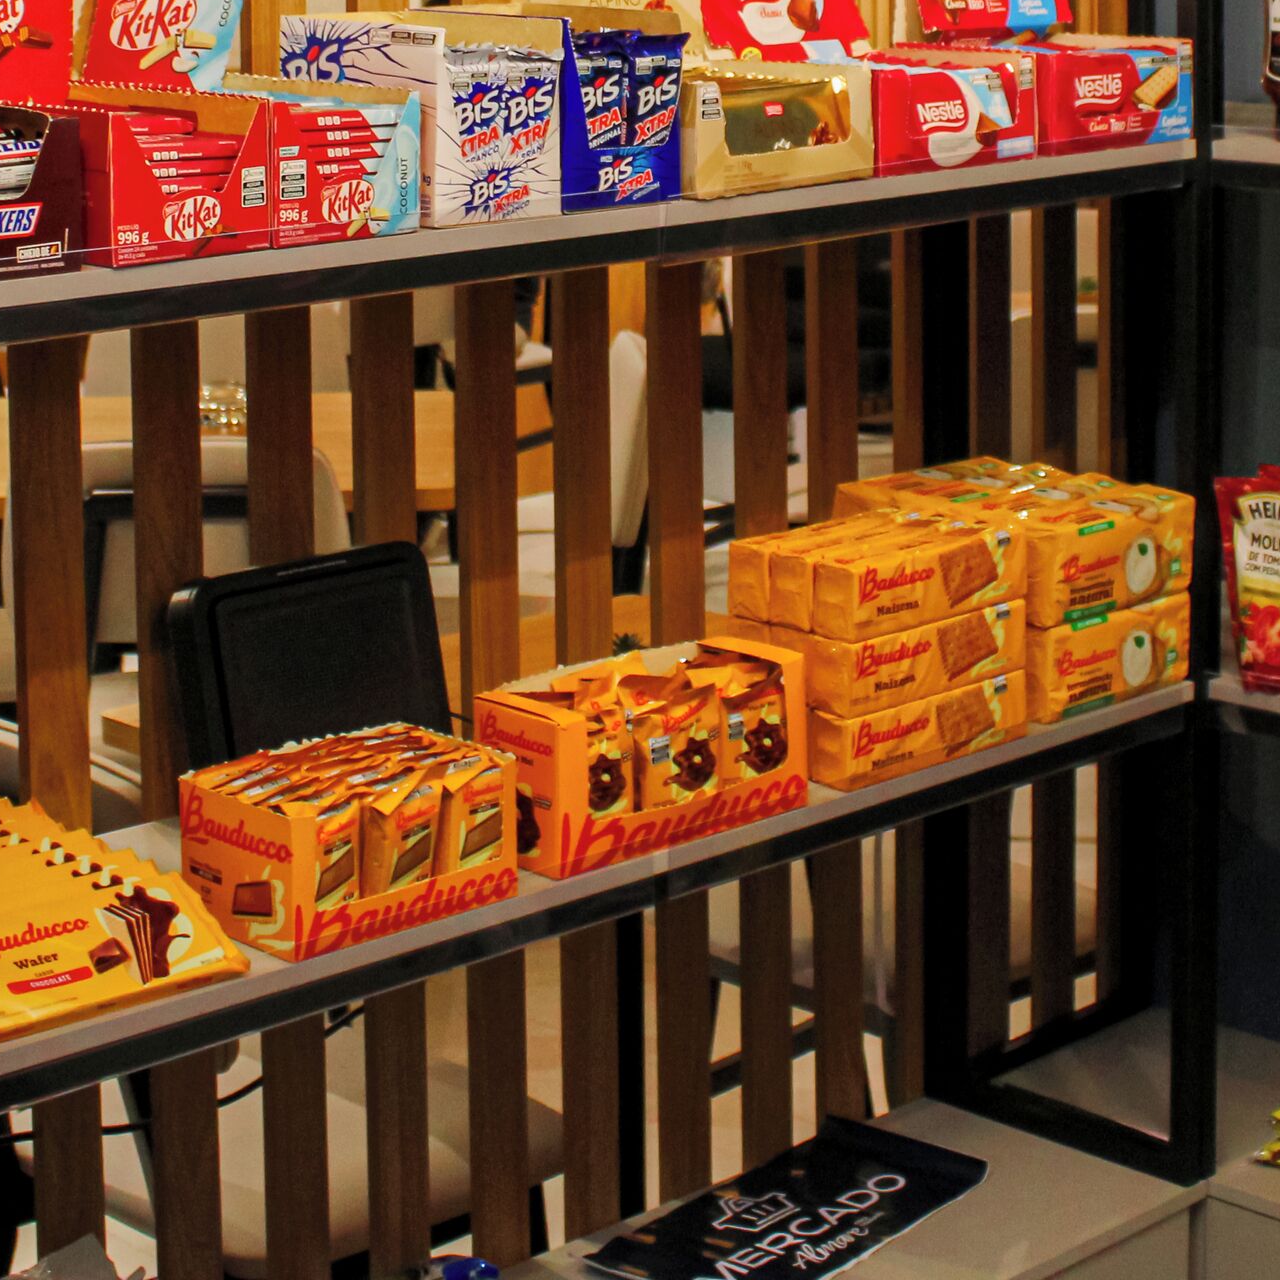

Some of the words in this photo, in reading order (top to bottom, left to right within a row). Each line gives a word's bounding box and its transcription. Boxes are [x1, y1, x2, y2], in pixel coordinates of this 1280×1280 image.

[400, 157, 408, 214] COCONUT
[118, 231, 139, 244] 996
[171, 197, 218, 240] KitKat
[1248, 552, 1260, 562] DE
[180, 786, 294, 864] Bauducco
[561, 774, 807, 878] Bauducco
[295, 867, 517, 961] Bauducco
[13, 953, 59, 970] Wafer
[29, 973, 73, 990] CHOCOLATE
